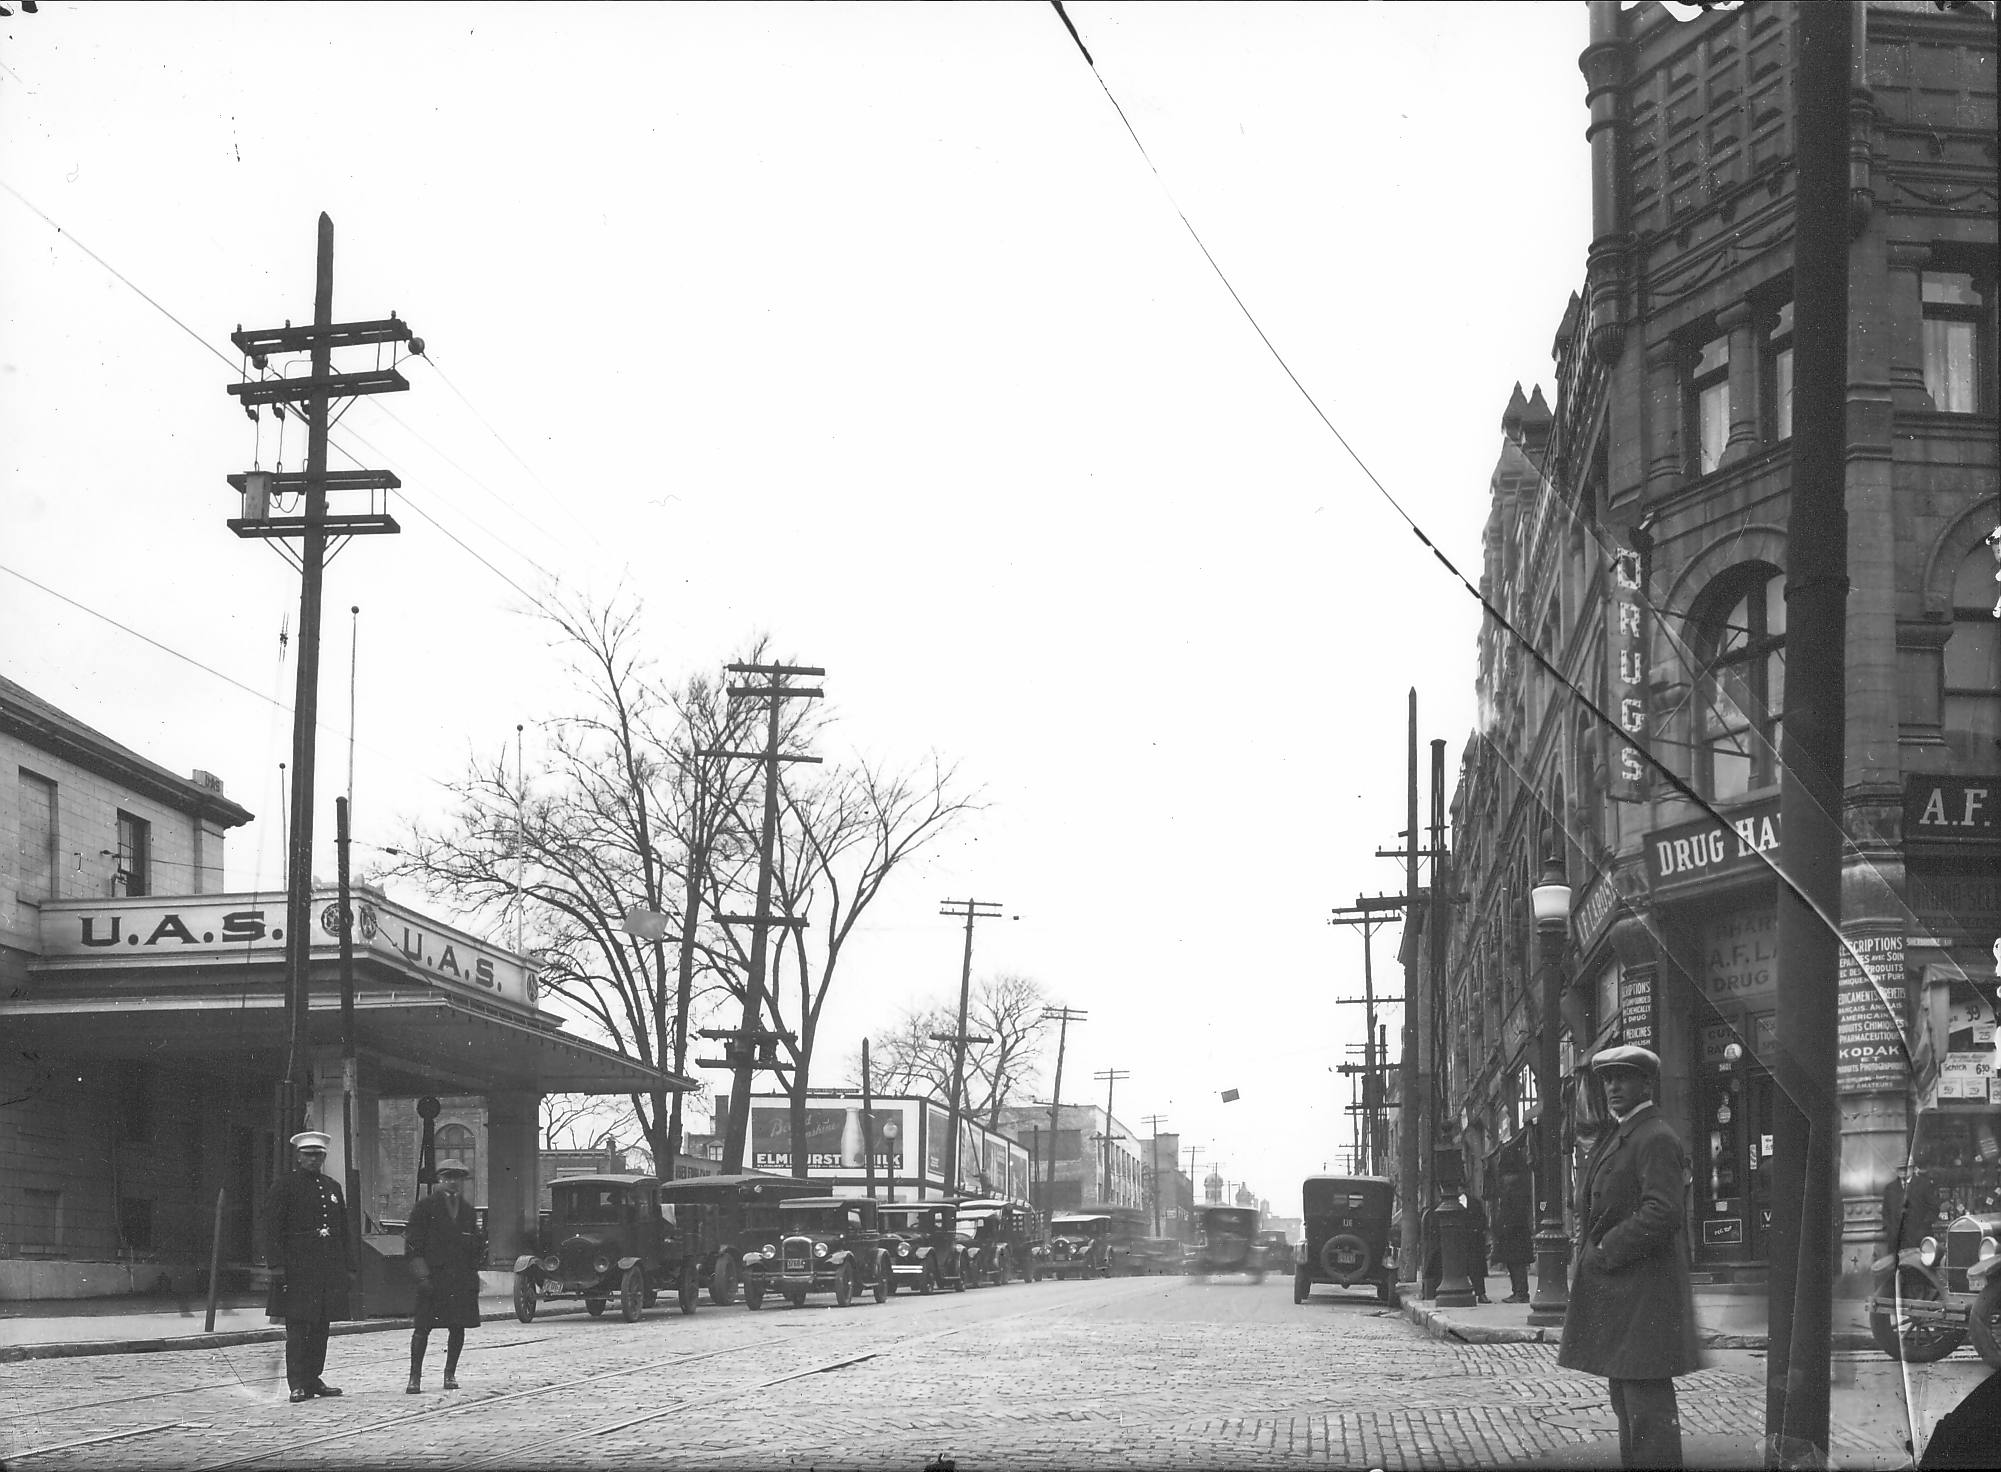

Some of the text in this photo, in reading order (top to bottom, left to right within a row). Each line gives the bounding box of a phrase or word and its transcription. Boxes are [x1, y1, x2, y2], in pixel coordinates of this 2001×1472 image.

[1617, 548, 1646, 780] DRUGS
[1919, 787, 1991, 827] A.F.
[1656, 812, 1781, 877] DRUG HA
[78, 910, 284, 947] U.A.S.
[403, 927, 502, 992] U.A.S.
[1886, 951, 1905, 962] SOIN
[1712, 969, 1769, 993] DRUG
[1966, 1005, 1981, 1022] 39
[1839, 1045, 1900, 1060] KODAK
